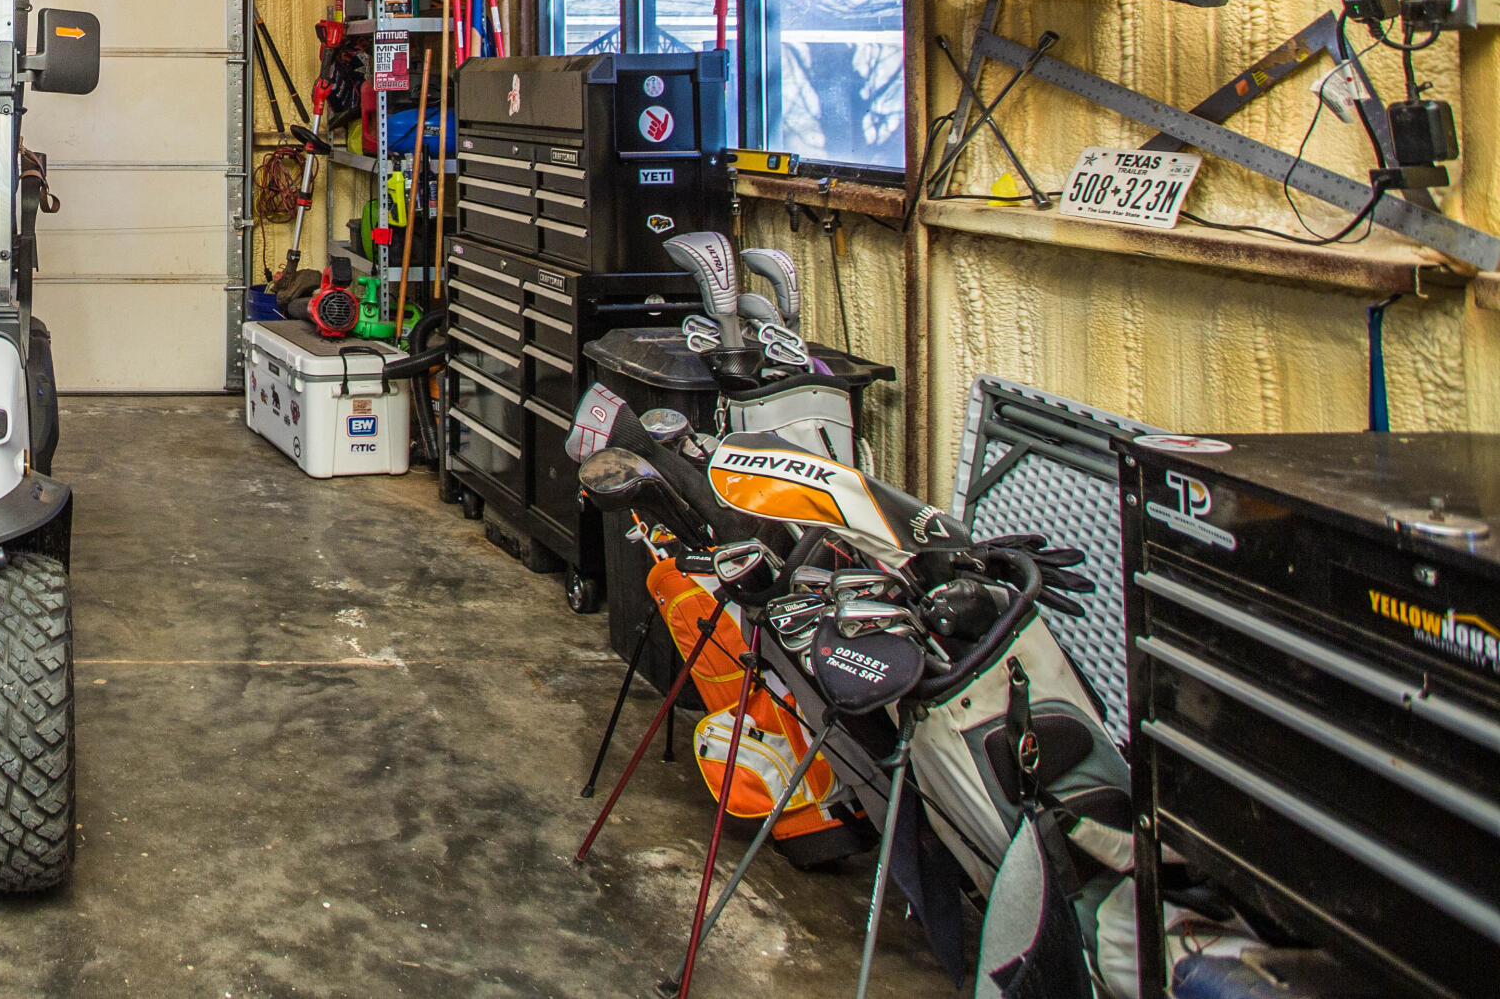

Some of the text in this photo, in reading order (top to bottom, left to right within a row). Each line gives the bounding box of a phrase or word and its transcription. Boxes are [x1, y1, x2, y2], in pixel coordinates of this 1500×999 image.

[376, 31, 408, 40] ATTITUDE
[376, 52, 391, 64] GETS
[376, 80, 408, 89] GARAGE
[552, 151, 576, 163] CRAFTSMAN
[1114, 153, 1162, 170] TEXAS
[642, 172, 671, 182] YETI
[1117, 167, 1149, 176] TRAILER
[705, 244, 724, 273] ULTRA
[539, 272, 564, 288] CRAFTSMAN
[351, 444, 377, 453] RTIC
[723, 453, 838, 486] MAVRIK
[784, 602, 808, 613] Wilson
[835, 647, 890, 673] ODYSSEY
[858, 668, 884, 684] SRT
